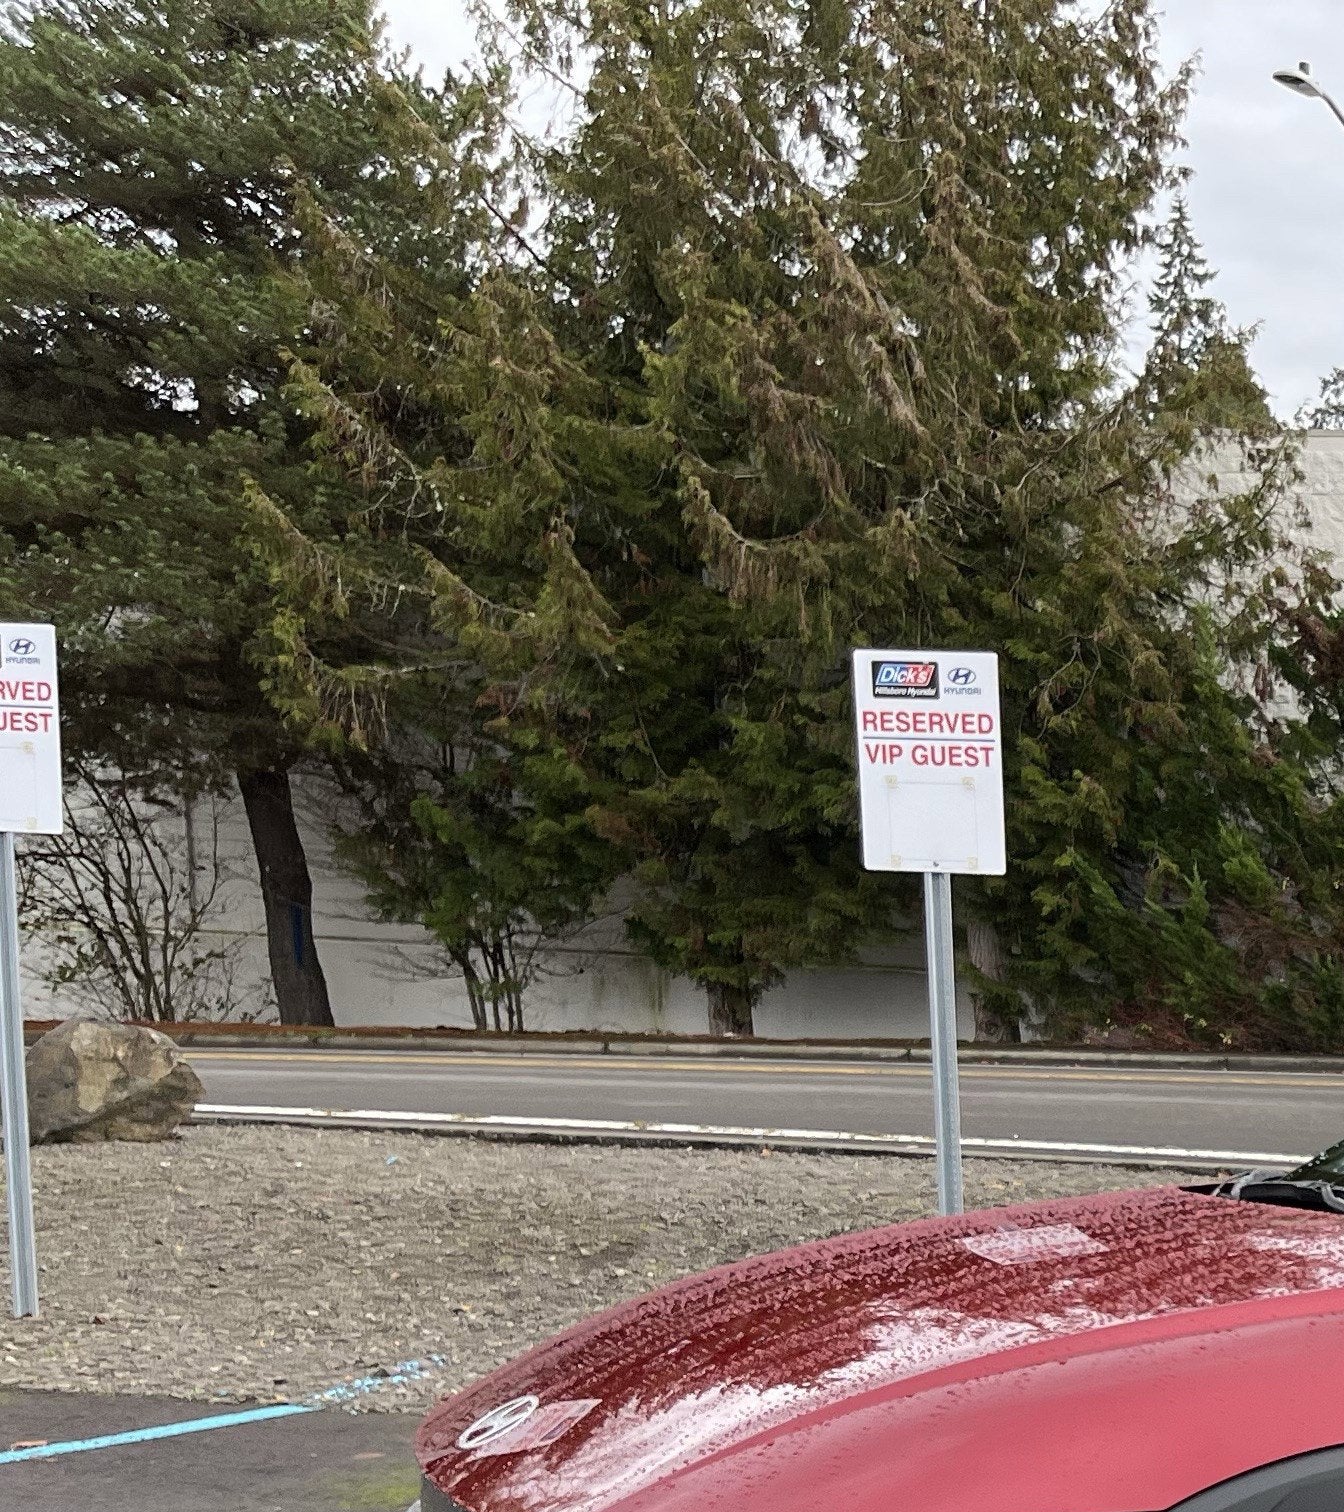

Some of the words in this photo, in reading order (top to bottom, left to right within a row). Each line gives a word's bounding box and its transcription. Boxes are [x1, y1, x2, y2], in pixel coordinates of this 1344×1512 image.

[944, 687, 982, 696] HYUNDAI
[862, 710, 994, 735] RESERVED
[865, 743, 903, 765] VIP
[911, 744, 994, 767] GUEST
